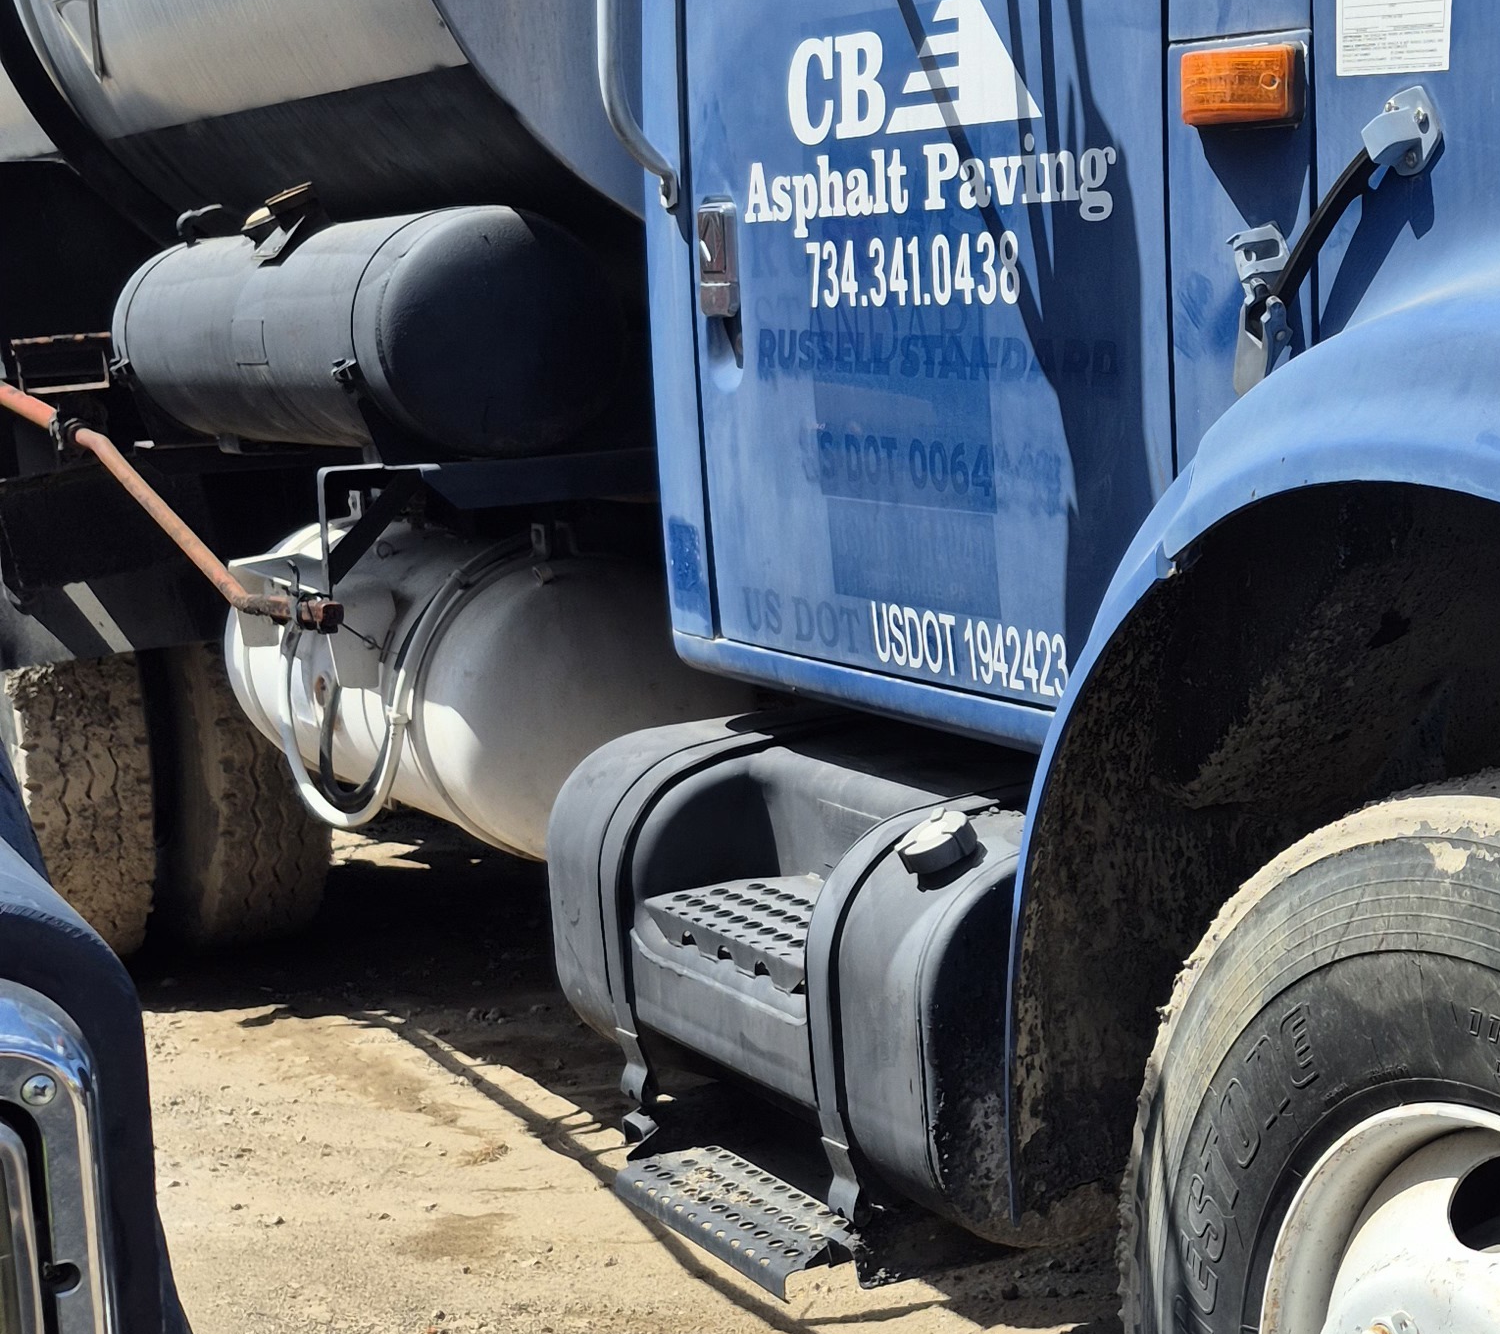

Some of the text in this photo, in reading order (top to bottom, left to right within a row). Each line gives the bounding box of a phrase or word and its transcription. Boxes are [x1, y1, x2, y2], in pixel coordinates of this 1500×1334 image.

[787, 31, 886, 146] CB
[744, 133, 1118, 239] Asphalt Paving
[805, 229, 1021, 309] 734.341.0438
[844, 433, 899, 487] DOT
[742, 585, 861, 655] US DOT
[870, 599, 1070, 699] USDOT 1942423
